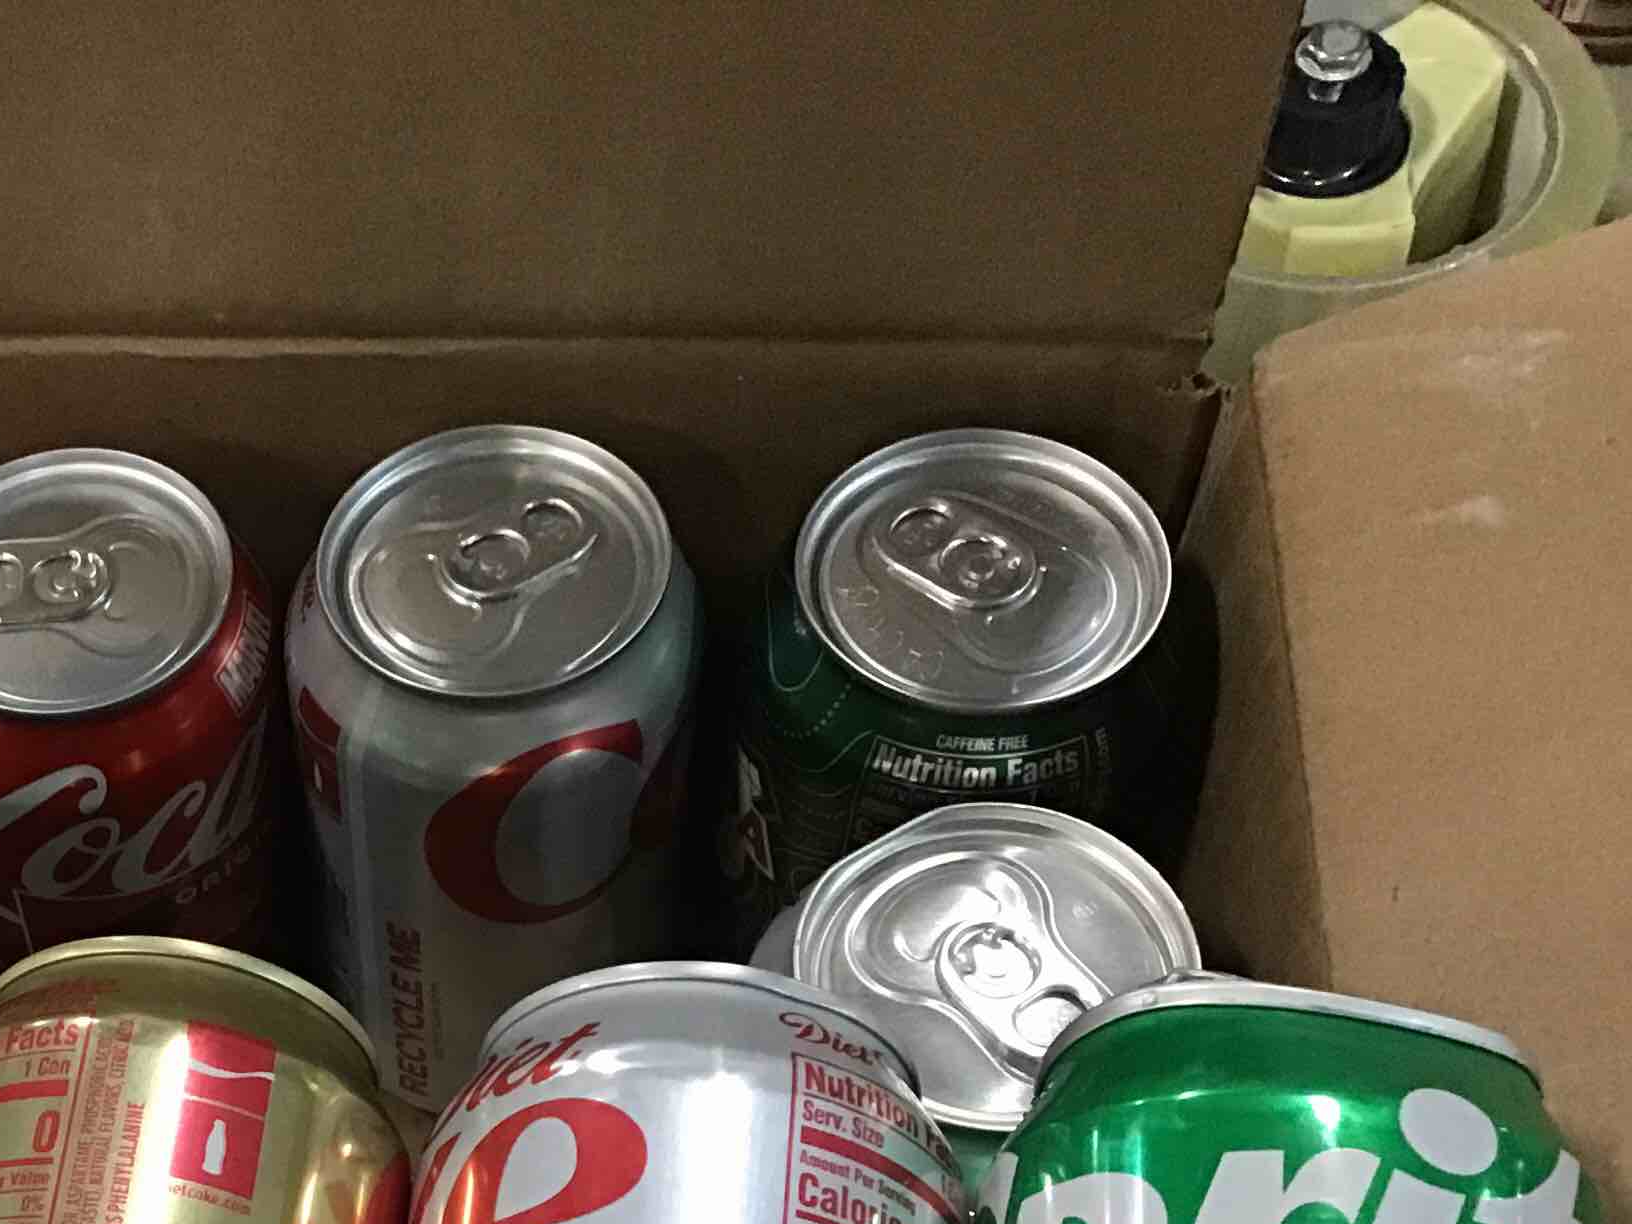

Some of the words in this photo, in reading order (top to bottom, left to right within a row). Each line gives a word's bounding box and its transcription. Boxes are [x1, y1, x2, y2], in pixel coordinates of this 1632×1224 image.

[871, 743, 998, 789] Nutrition
[1006, 748, 1080, 786] Facts
[386, 920, 419, 973] ME
[7, 1017, 80, 1054] Facts
[389, 972, 426, 1096] RECYCLE
[778, 1012, 881, 1068] Diet
[803, 1061, 919, 1138] Nutrition
[803, 1099, 847, 1133] Serv.
[852, 1115, 885, 1149] Size
[31, 1110, 63, 1154] 0
[798, 1148, 851, 1180] Amount
